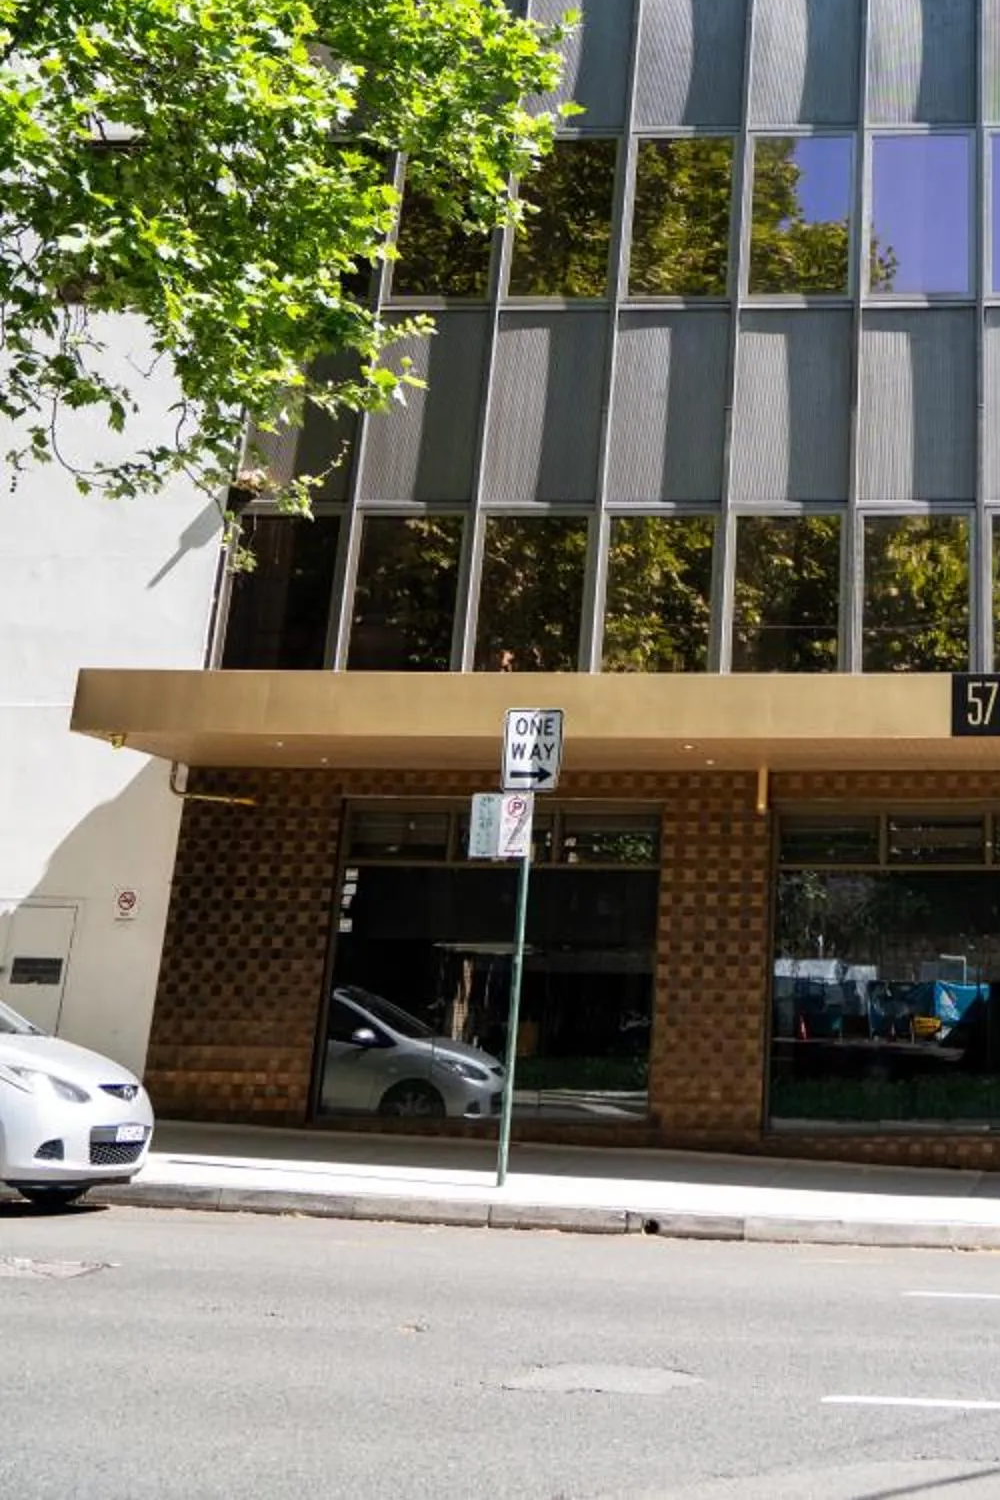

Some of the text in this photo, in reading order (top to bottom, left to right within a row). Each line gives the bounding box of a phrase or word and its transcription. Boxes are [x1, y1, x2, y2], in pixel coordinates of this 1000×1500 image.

[967, 681, 999, 725] 57
[515, 717, 555, 736] ONE
[511, 743, 555, 761] WAY
